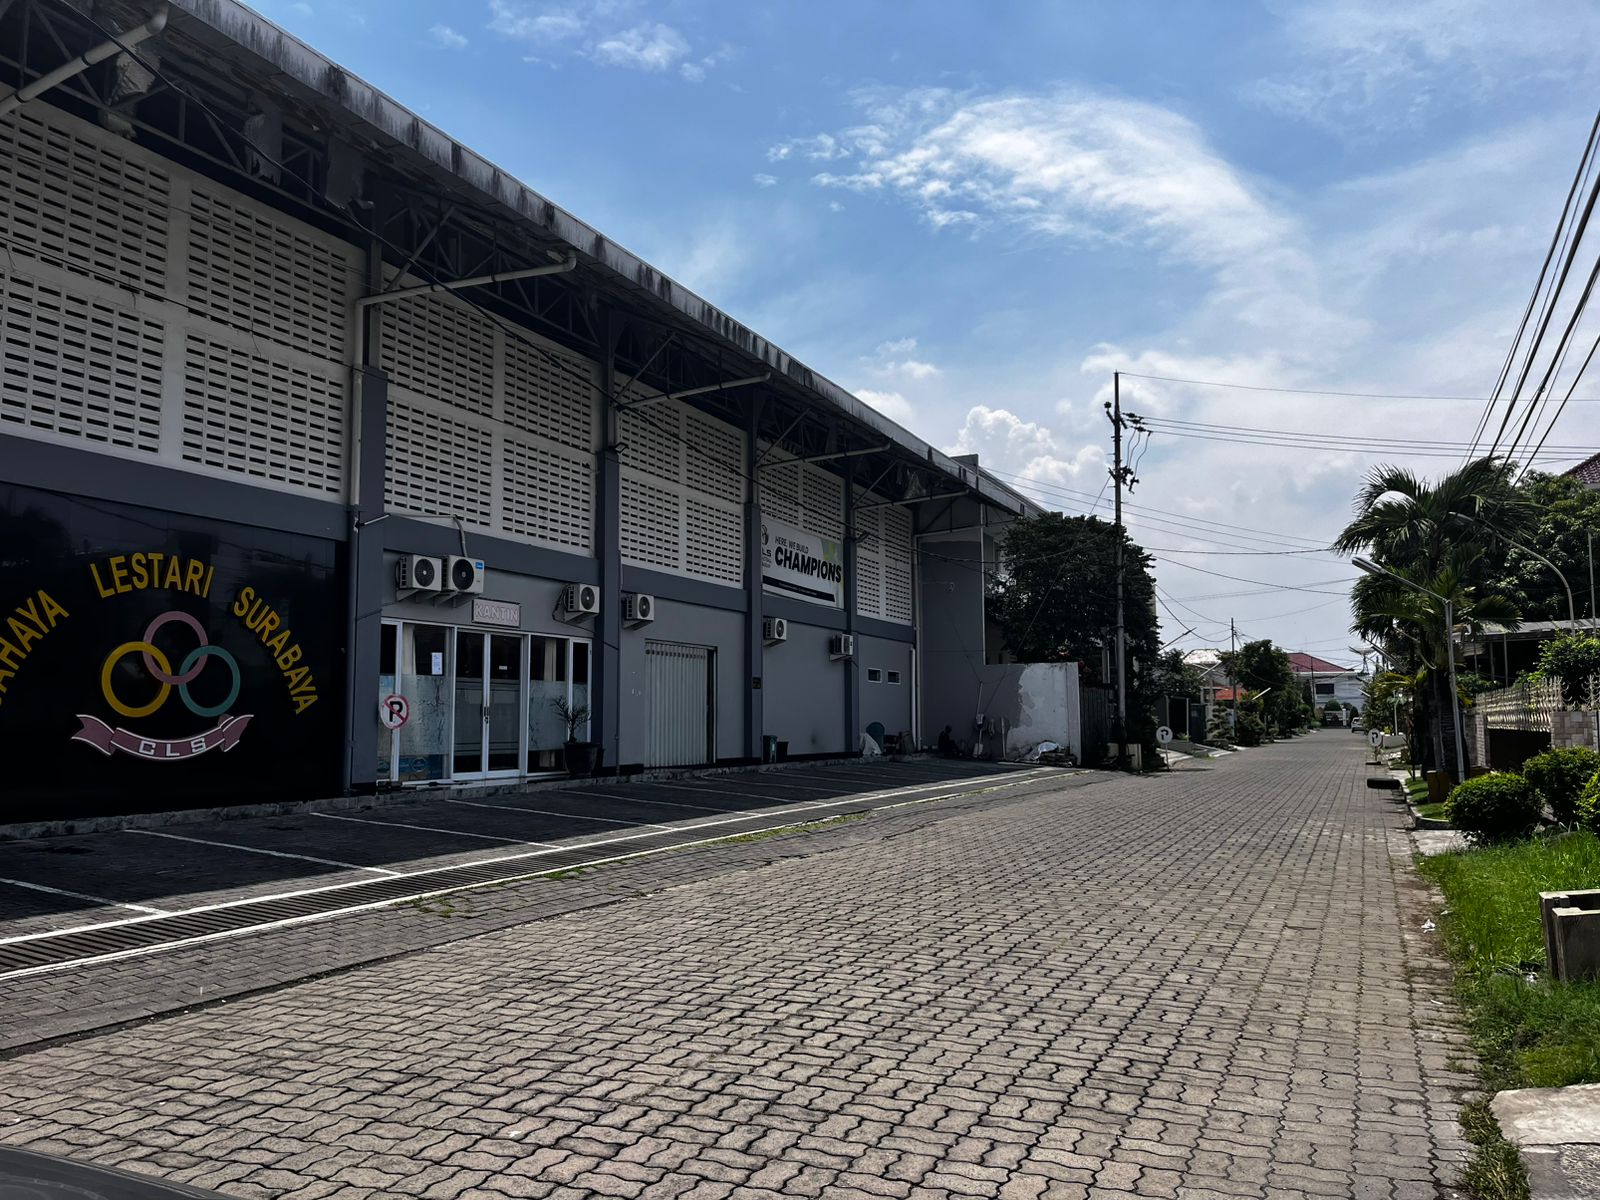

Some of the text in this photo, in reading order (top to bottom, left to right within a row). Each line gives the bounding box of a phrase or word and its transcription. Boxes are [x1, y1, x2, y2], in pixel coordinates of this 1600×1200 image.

[775, 546, 842, 583] CHAMPIONS
[474, 603, 519, 623] KANTIN
[0, 552, 319, 715] HAYA LESTARI SURABAYA
[390, 701, 403, 722] P
[139, 738, 207, 757] CLS
